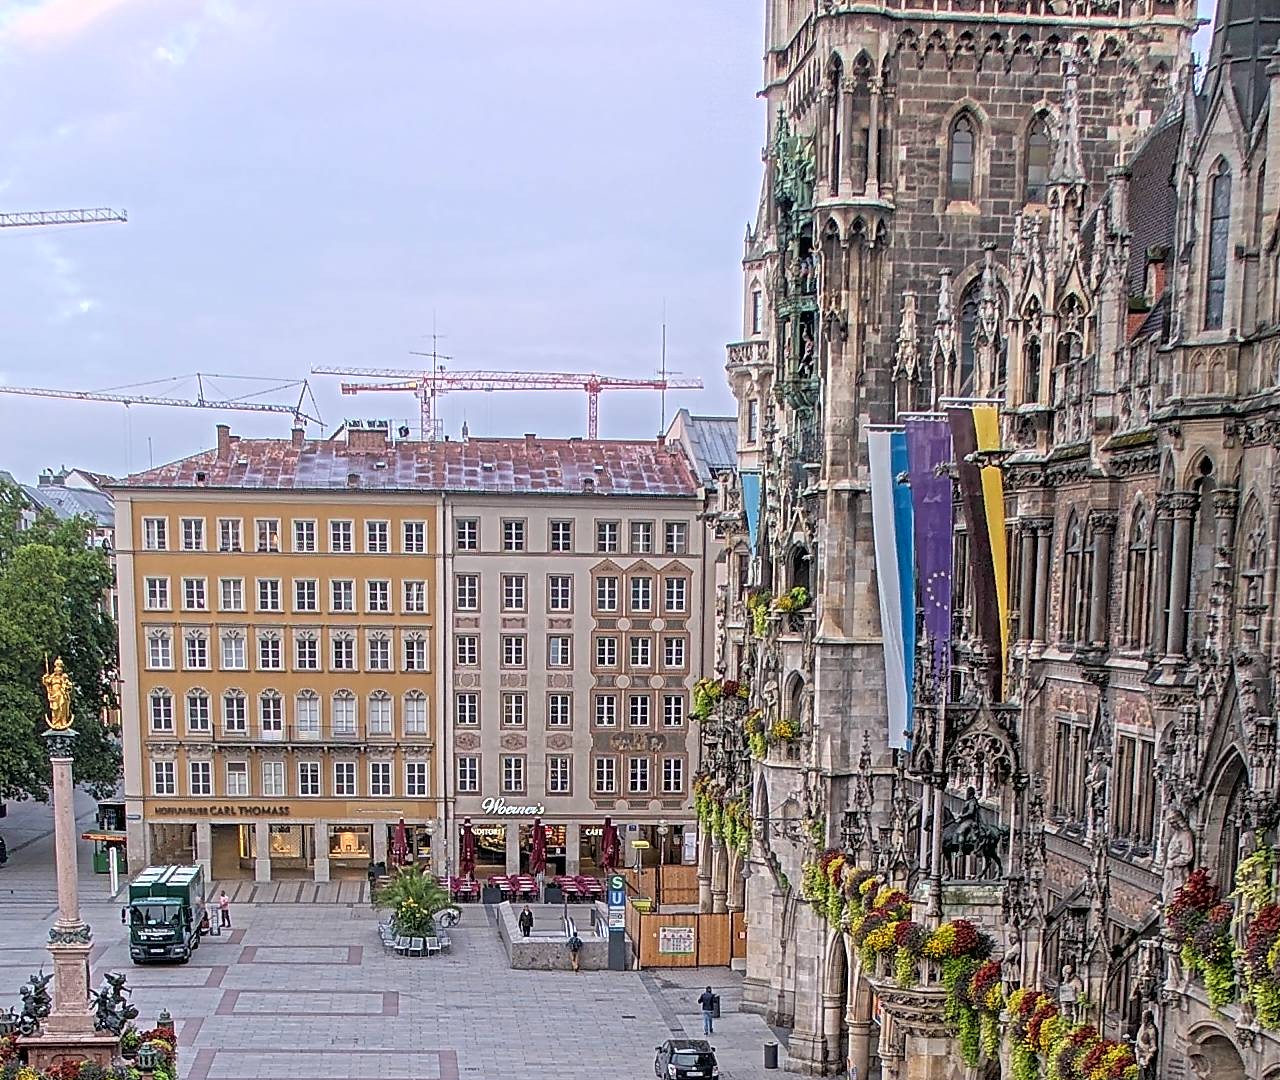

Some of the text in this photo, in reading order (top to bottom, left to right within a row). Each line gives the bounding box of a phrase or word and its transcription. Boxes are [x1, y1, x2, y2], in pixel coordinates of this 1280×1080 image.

[210, 806, 236, 816] CARL
[238, 806, 290, 817] THOMASS
[481, 797, 545, 816] Woerner's
[611, 876, 624, 890] S
[612, 892, 623, 905] U
